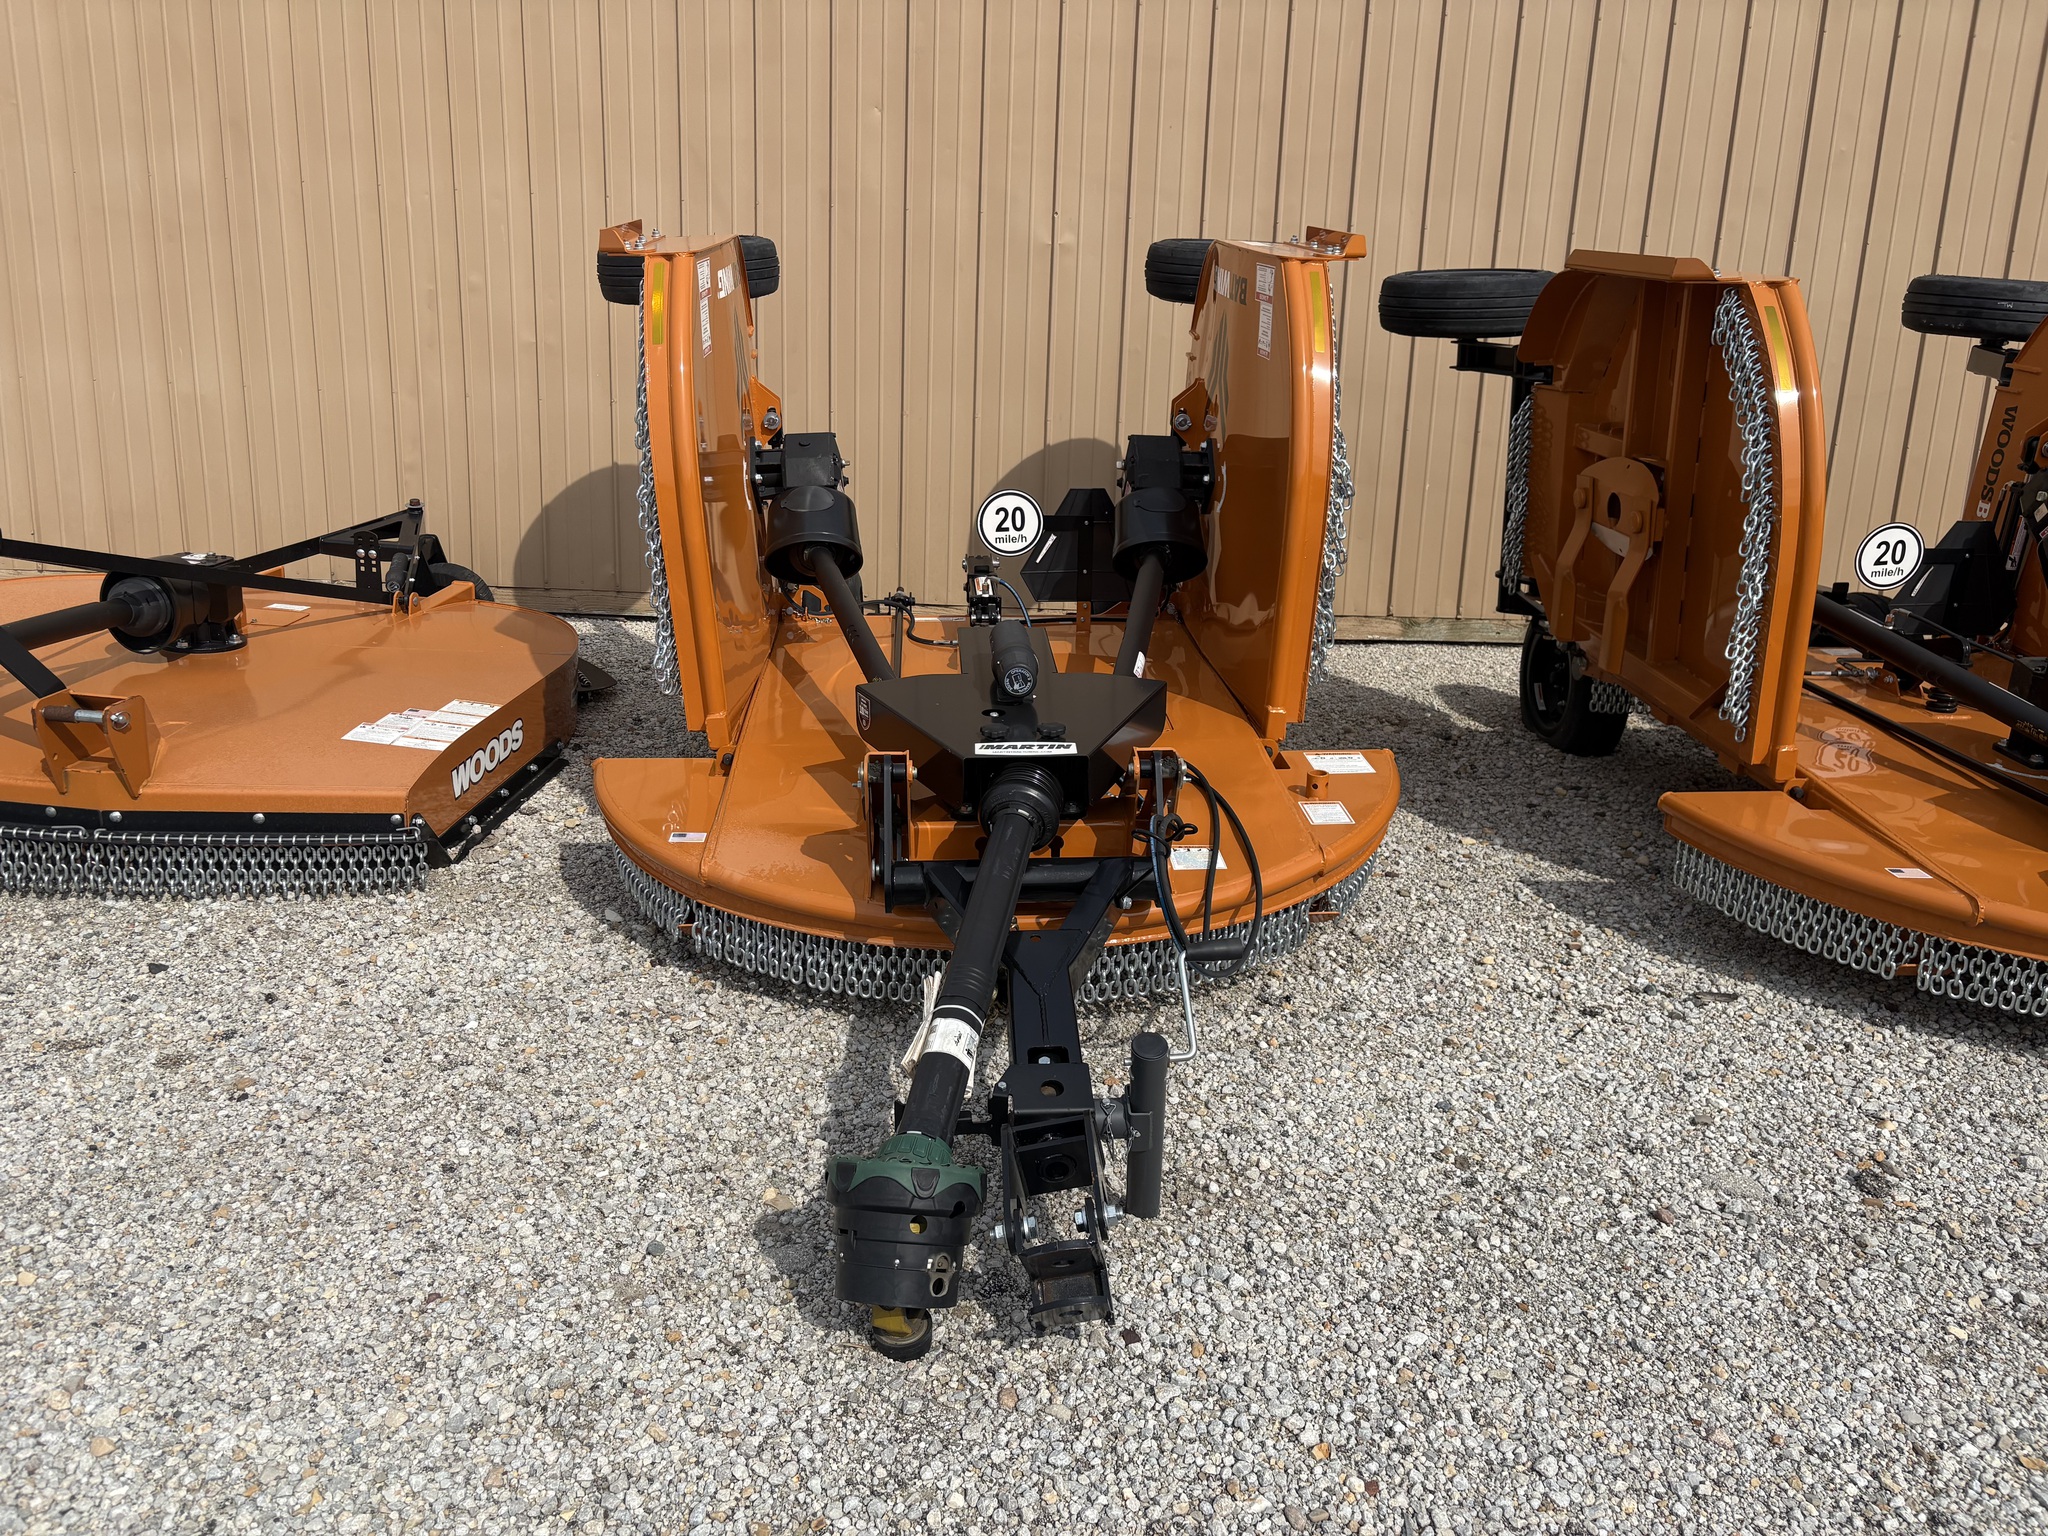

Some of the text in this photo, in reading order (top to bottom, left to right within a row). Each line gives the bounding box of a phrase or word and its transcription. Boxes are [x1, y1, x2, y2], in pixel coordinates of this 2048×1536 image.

[1980, 405, 2018, 503] WOODS
[995, 506, 1026, 533] 20
[994, 534, 1027, 544] mile/h
[1873, 539, 1907, 566] 20
[1870, 567, 1904, 578] mile/h
[451, 717, 524, 801] WOODS
